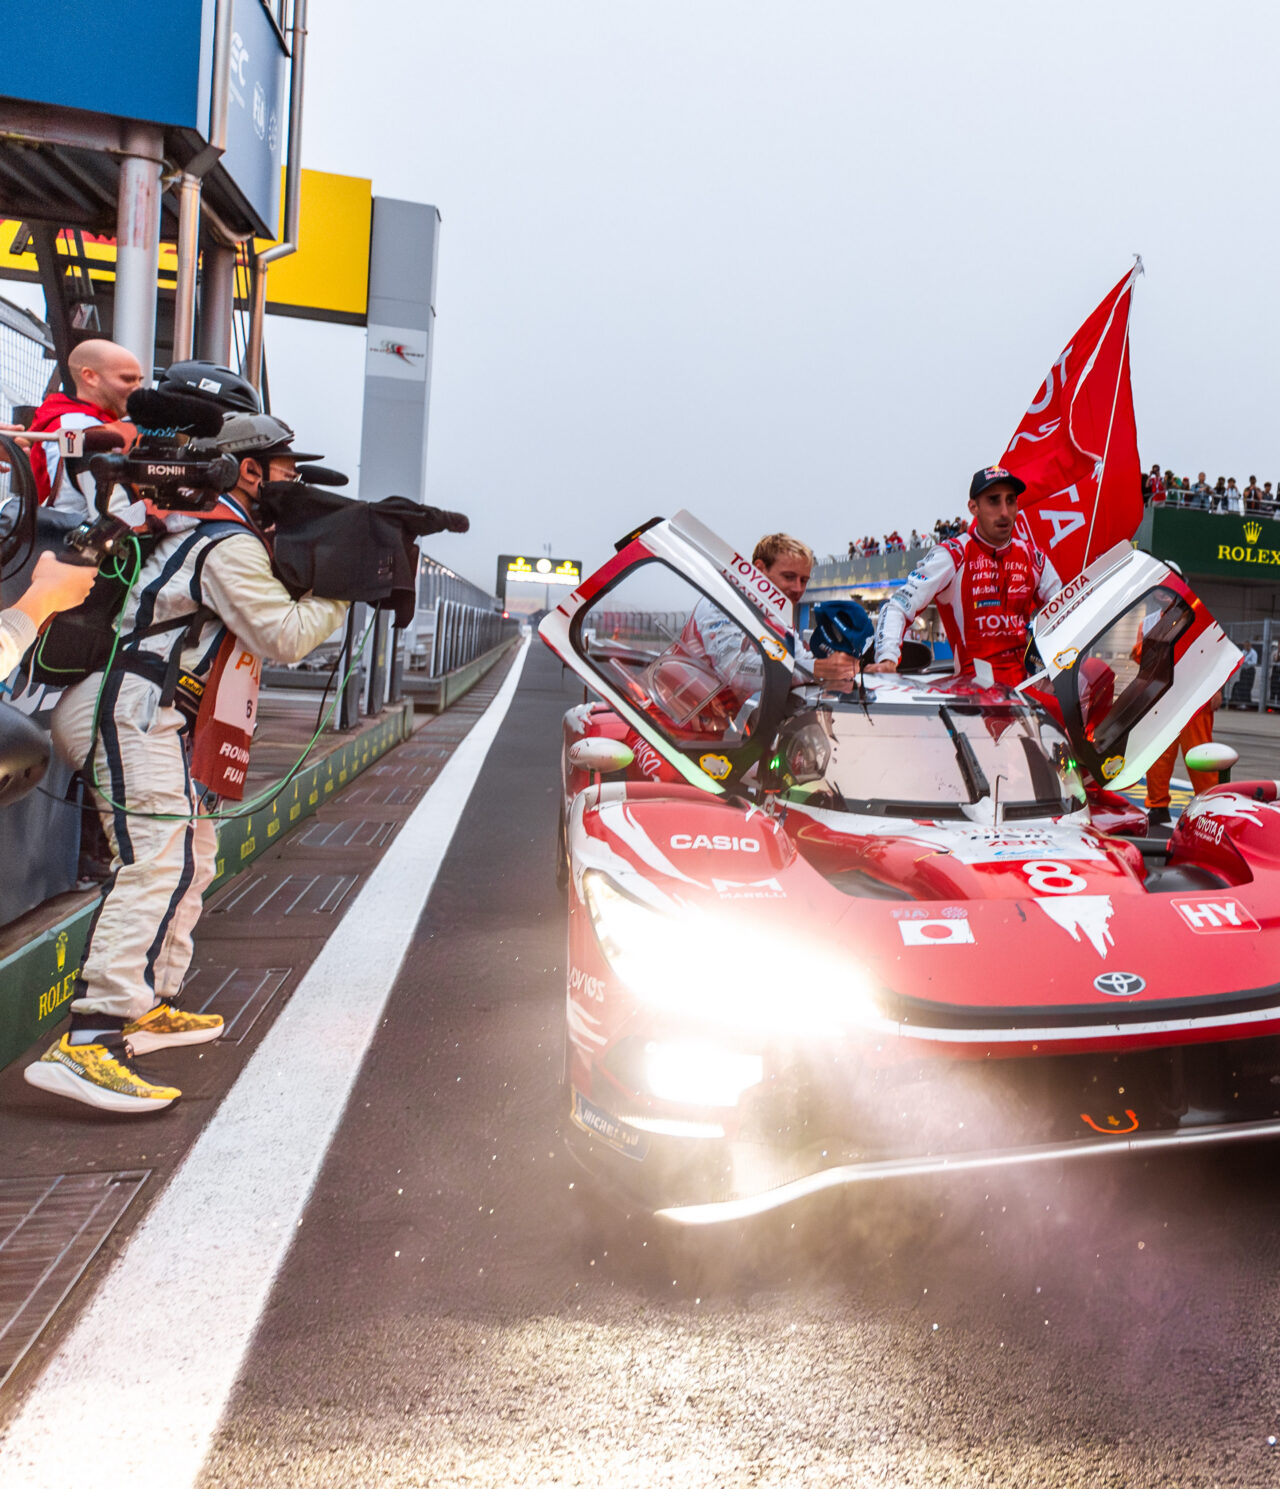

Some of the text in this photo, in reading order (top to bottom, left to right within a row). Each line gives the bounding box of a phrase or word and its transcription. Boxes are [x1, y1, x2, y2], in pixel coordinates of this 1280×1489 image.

[147, 464, 186, 476] RONIN
[731, 552, 787, 611] TOYOTA
[1041, 575, 1090, 621] TOYOTA
[670, 834, 760, 853] CASIO
[1196, 816, 1218, 835] TOYOTA
[1215, 824, 1225, 846] 8
[1022, 860, 1088, 894] 8
[719, 891, 788, 899] MARELLI
[1179, 902, 1242, 927] HY
